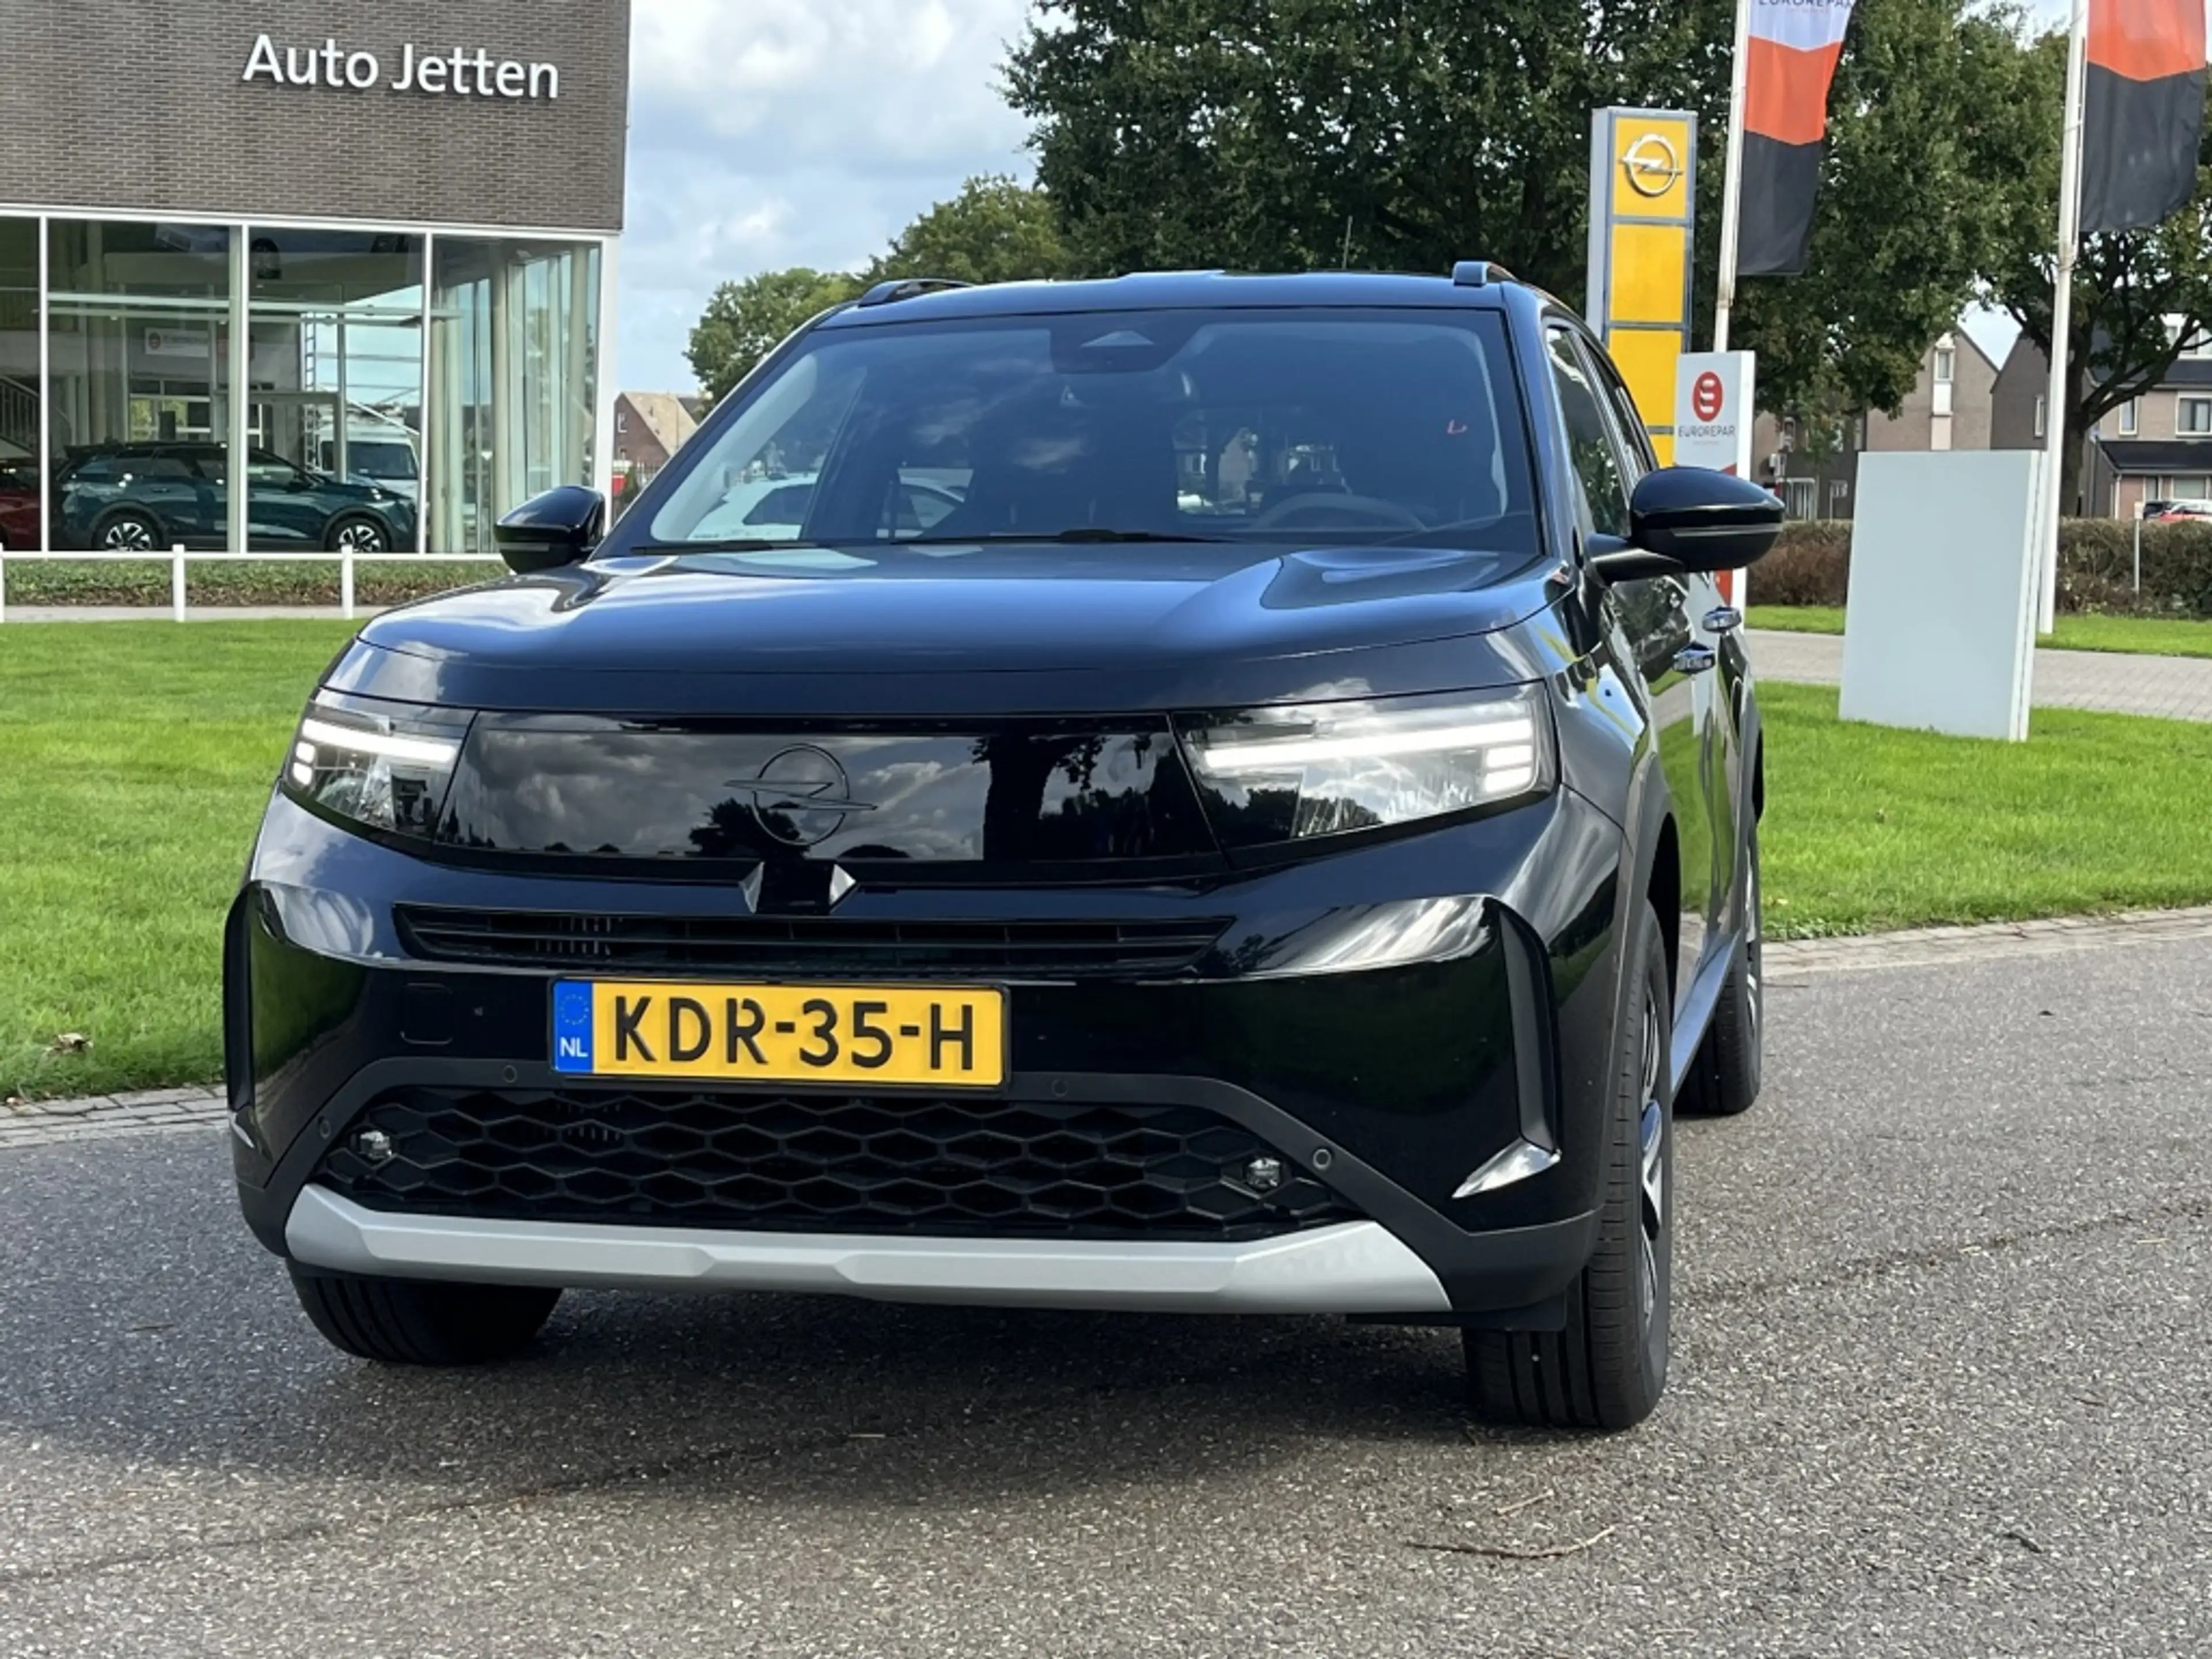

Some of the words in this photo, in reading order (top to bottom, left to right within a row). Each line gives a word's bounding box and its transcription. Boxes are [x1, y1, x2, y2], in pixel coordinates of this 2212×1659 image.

[242, 35, 378, 88] Auto
[392, 44, 559, 98] Jetten
[1679, 425, 1735, 437] EUROREPAR
[560, 1038, 588, 1058] NL
[614, 995, 974, 1070] KDR-35-H
